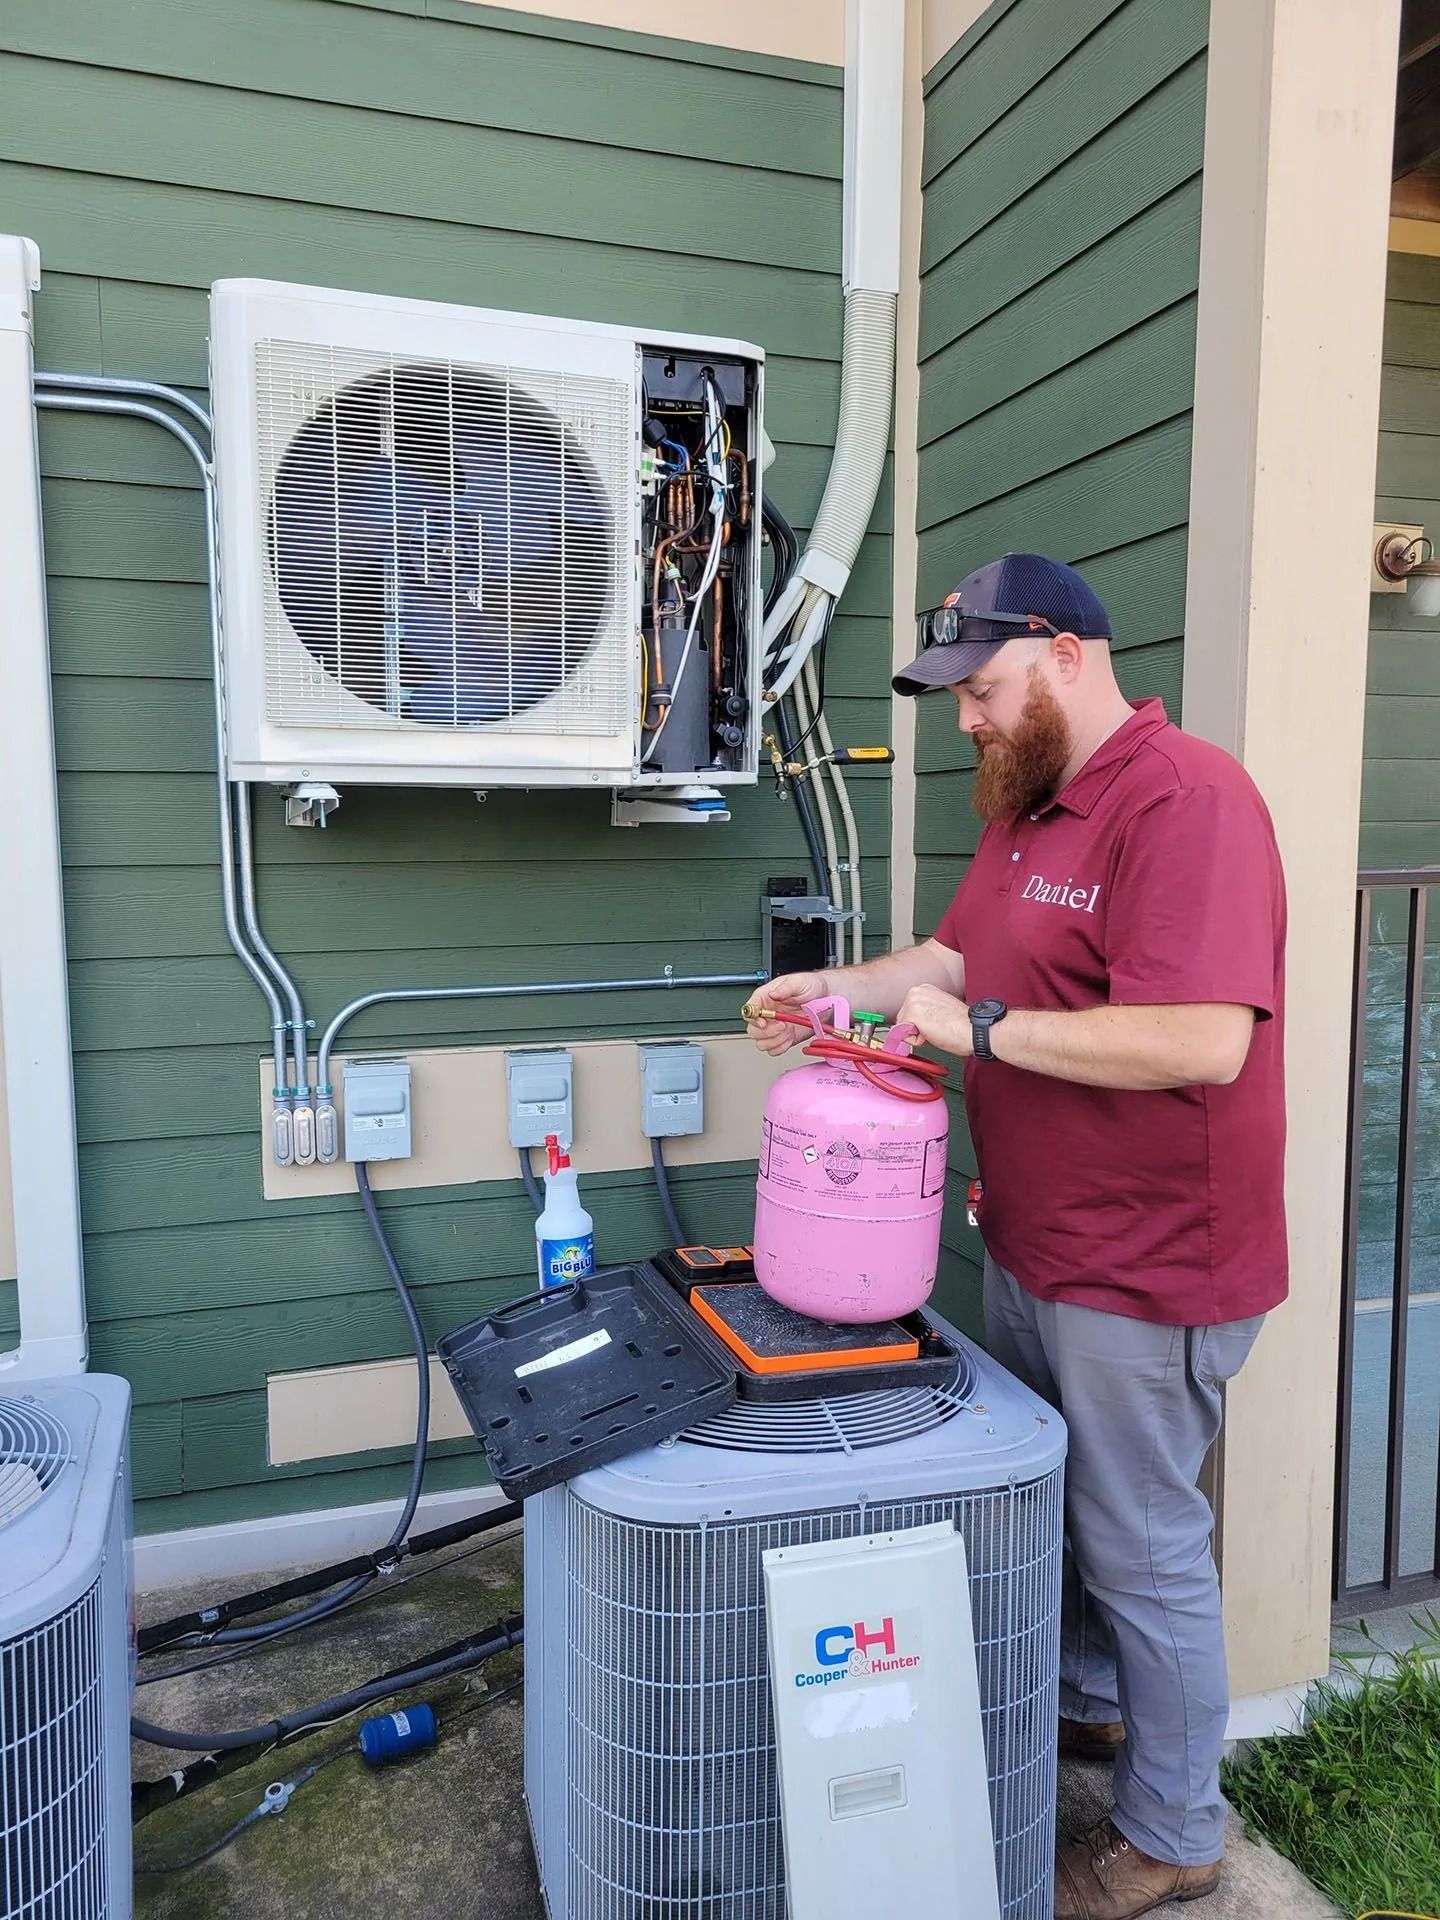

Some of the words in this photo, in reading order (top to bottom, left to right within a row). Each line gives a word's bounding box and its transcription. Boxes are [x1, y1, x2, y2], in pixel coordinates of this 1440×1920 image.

[1021, 875, 1101, 913] Daniel
[826, 1157, 860, 1170] 410A
[552, 1262, 572, 1273] BIG
[573, 1256, 592, 1273] BLU
[815, 1617, 896, 1666] CH
[795, 1669, 848, 1687] Cooper
[848, 1650, 870, 1677] &
[871, 1655, 920, 1673] Hunter
